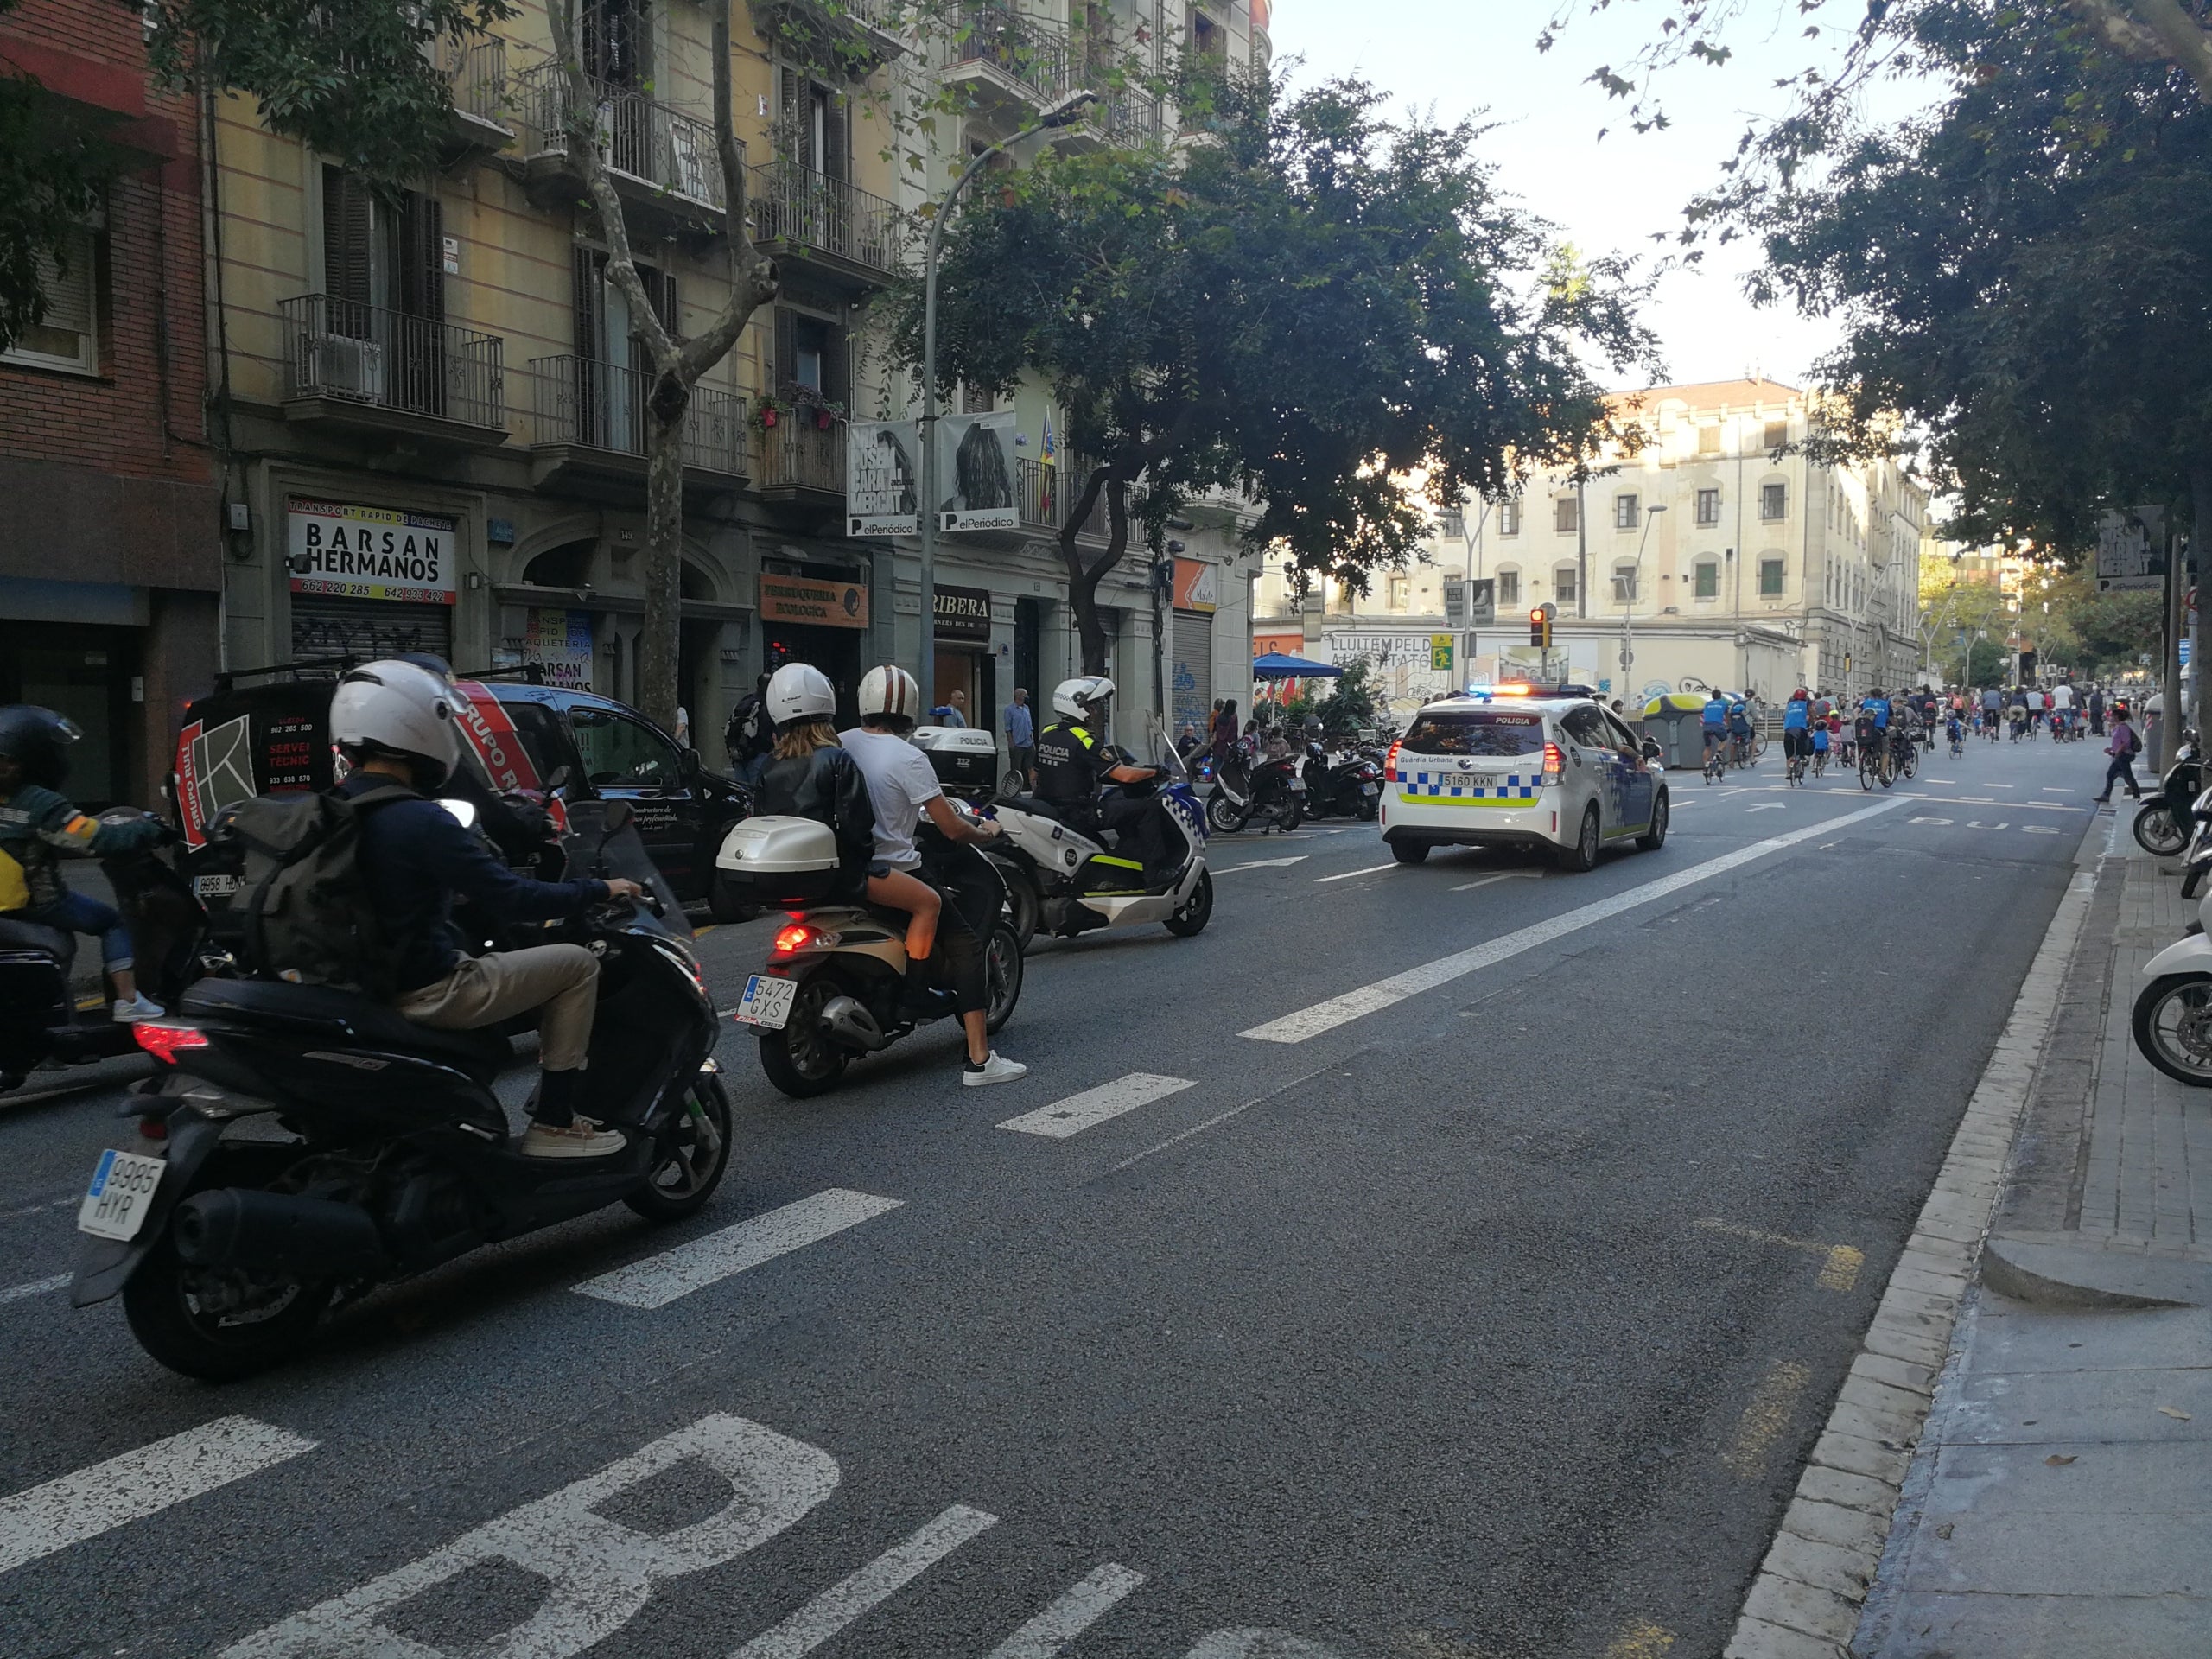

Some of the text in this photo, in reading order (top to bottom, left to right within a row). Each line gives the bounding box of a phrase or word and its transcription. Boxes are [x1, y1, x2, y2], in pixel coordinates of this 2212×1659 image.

[851, 468, 885, 491] CARA
[851, 491, 903, 513] MERCAT
[289, 501, 355, 517] TRANSPORT
[361, 510, 391, 522] RAPID
[397, 514, 408, 524] DE
[865, 523, 912, 534] elPeriódico
[960, 518, 1014, 529] elPeriódico
[307, 524, 438, 559] BARSAN
[307, 548, 438, 582] HERMANOS
[302, 581, 444, 601] 662 220 285 642 933 422
[270, 742, 310, 753] SERVEI
[960, 737, 987, 746] POLICIA
[1039, 744, 1069, 757] POLICIA
[182, 741, 200, 830] GRUPO RULL
[1445, 776, 1493, 786] 5160 KKN
[756, 980, 793, 1001] 5472
[750, 998, 781, 1018] GXS
